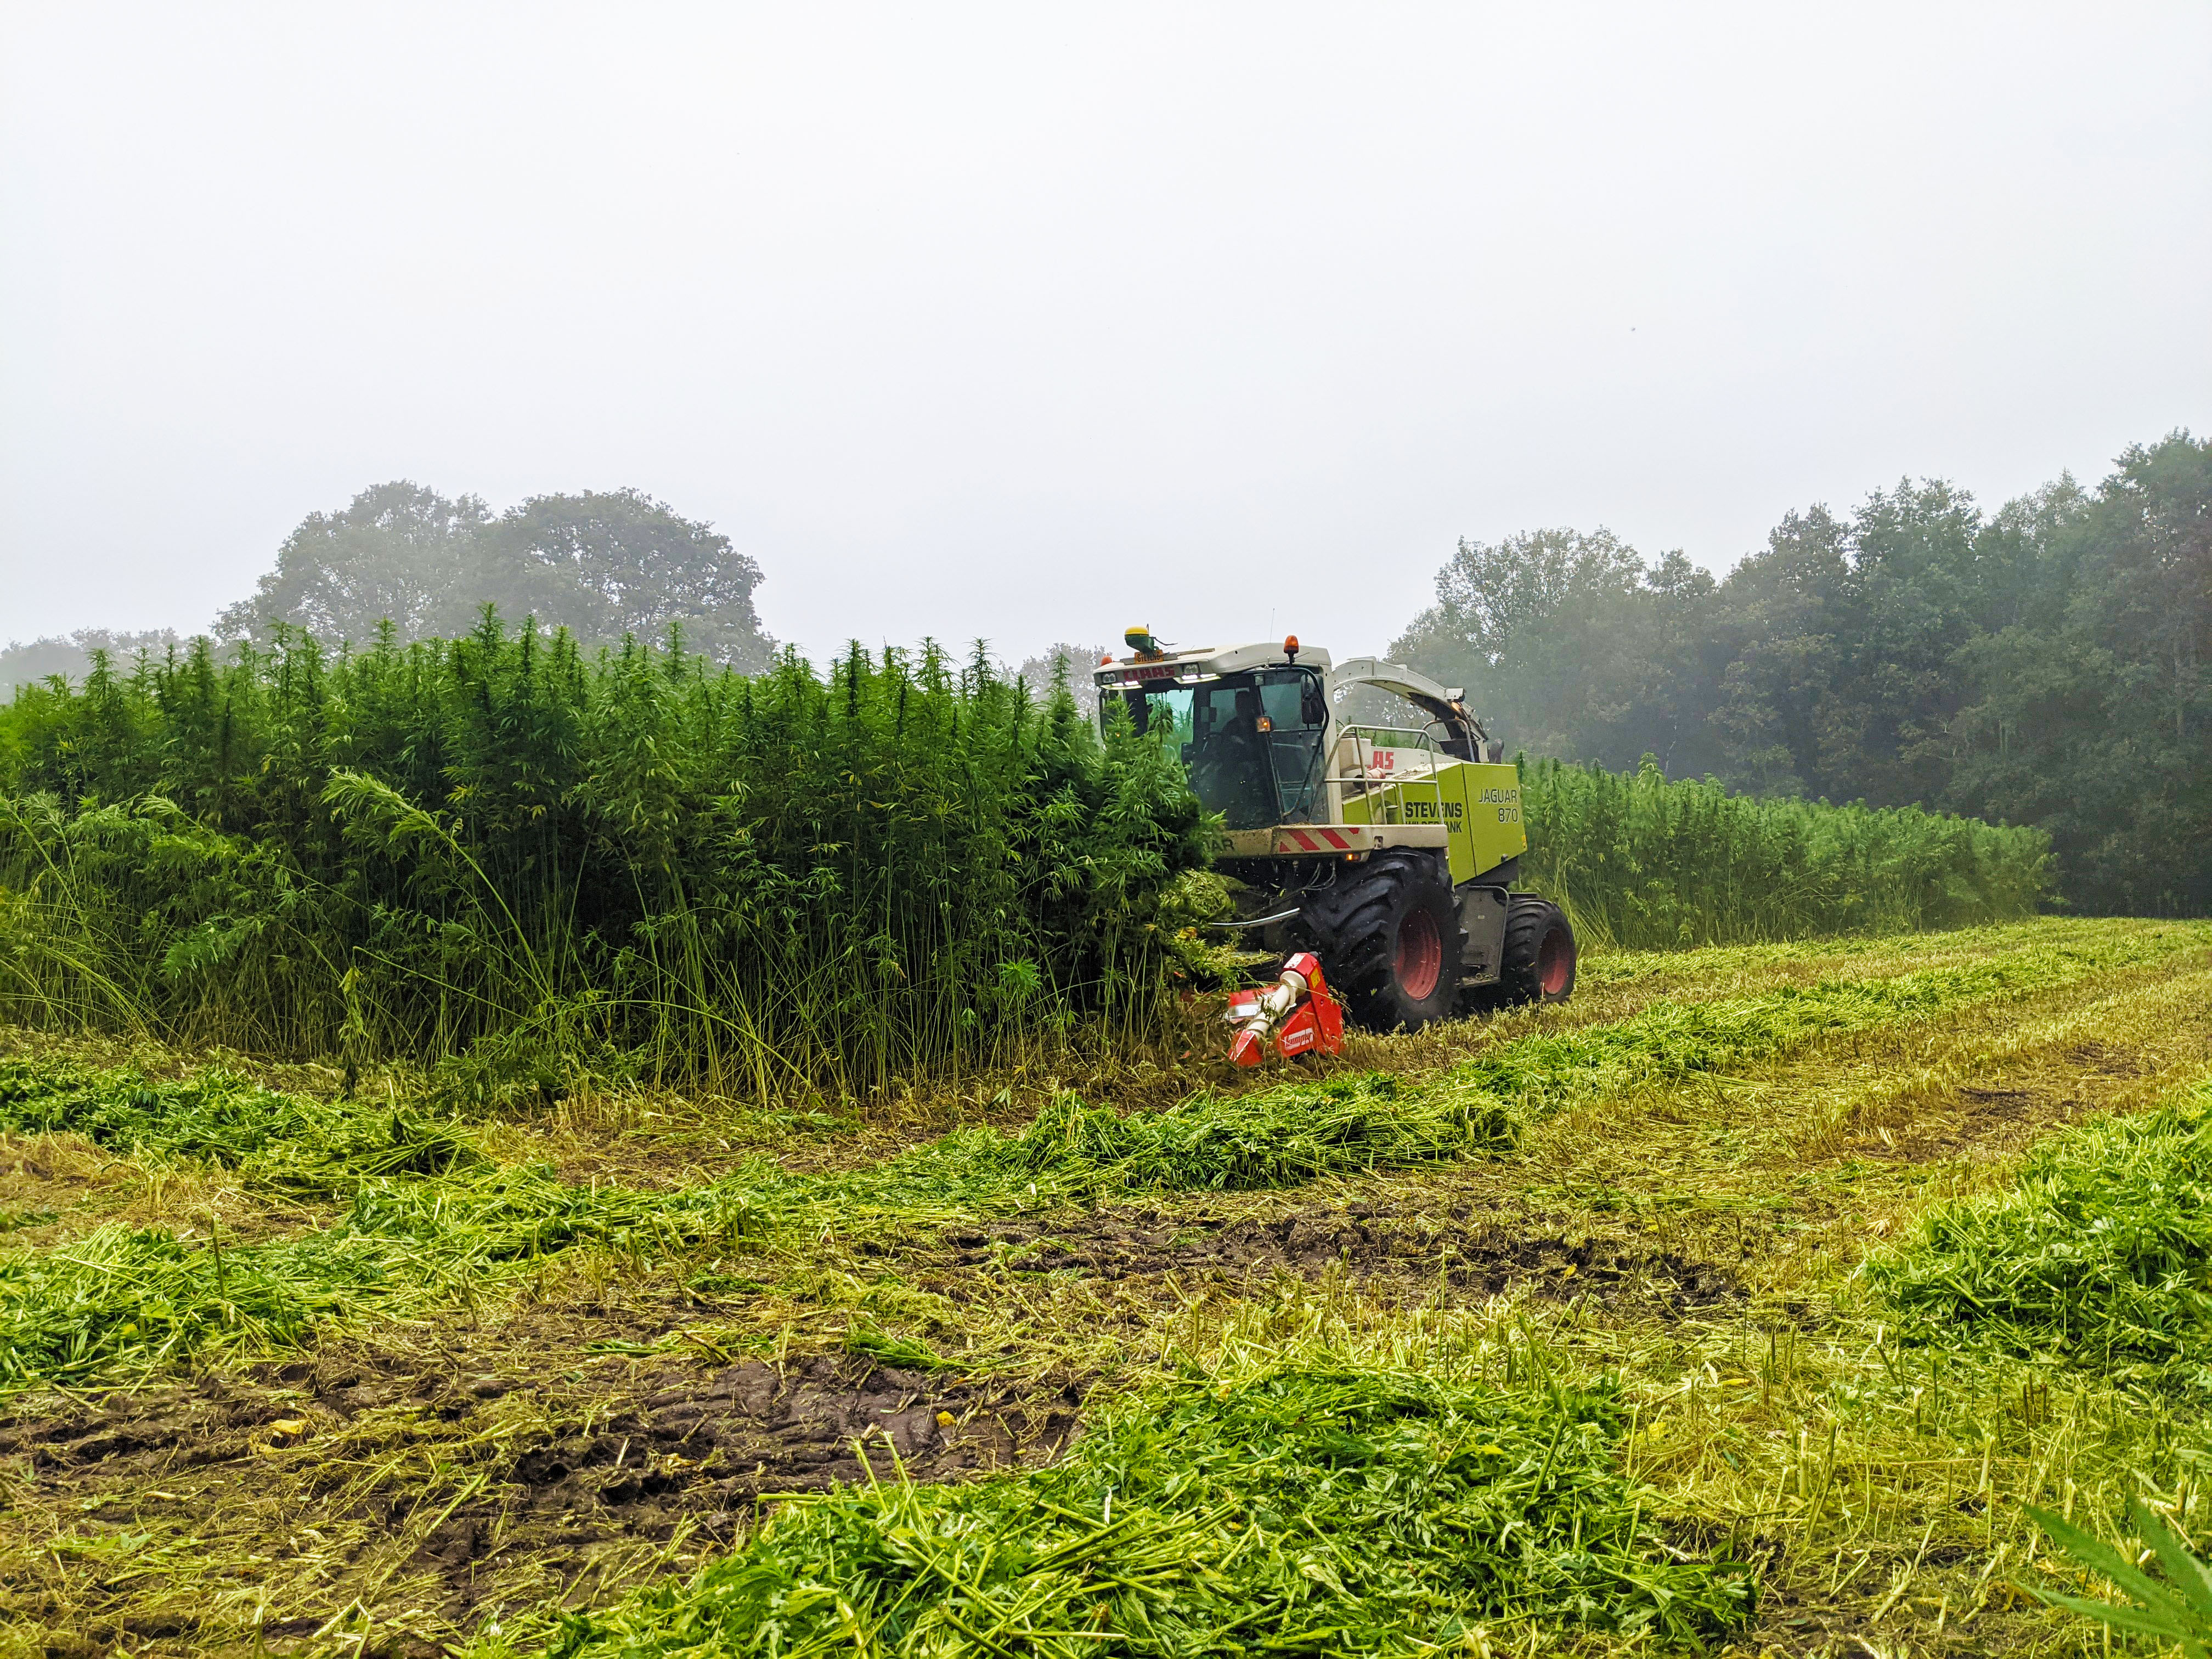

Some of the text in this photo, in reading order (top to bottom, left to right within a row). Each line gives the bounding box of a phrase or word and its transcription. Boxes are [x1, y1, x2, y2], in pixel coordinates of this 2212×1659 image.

[1124, 667, 1175, 681] CLAAS
[1366, 751, 1394, 770] AS
[1479, 788, 1517, 804] JAGUAR
[1498, 808, 1518, 822] 870
